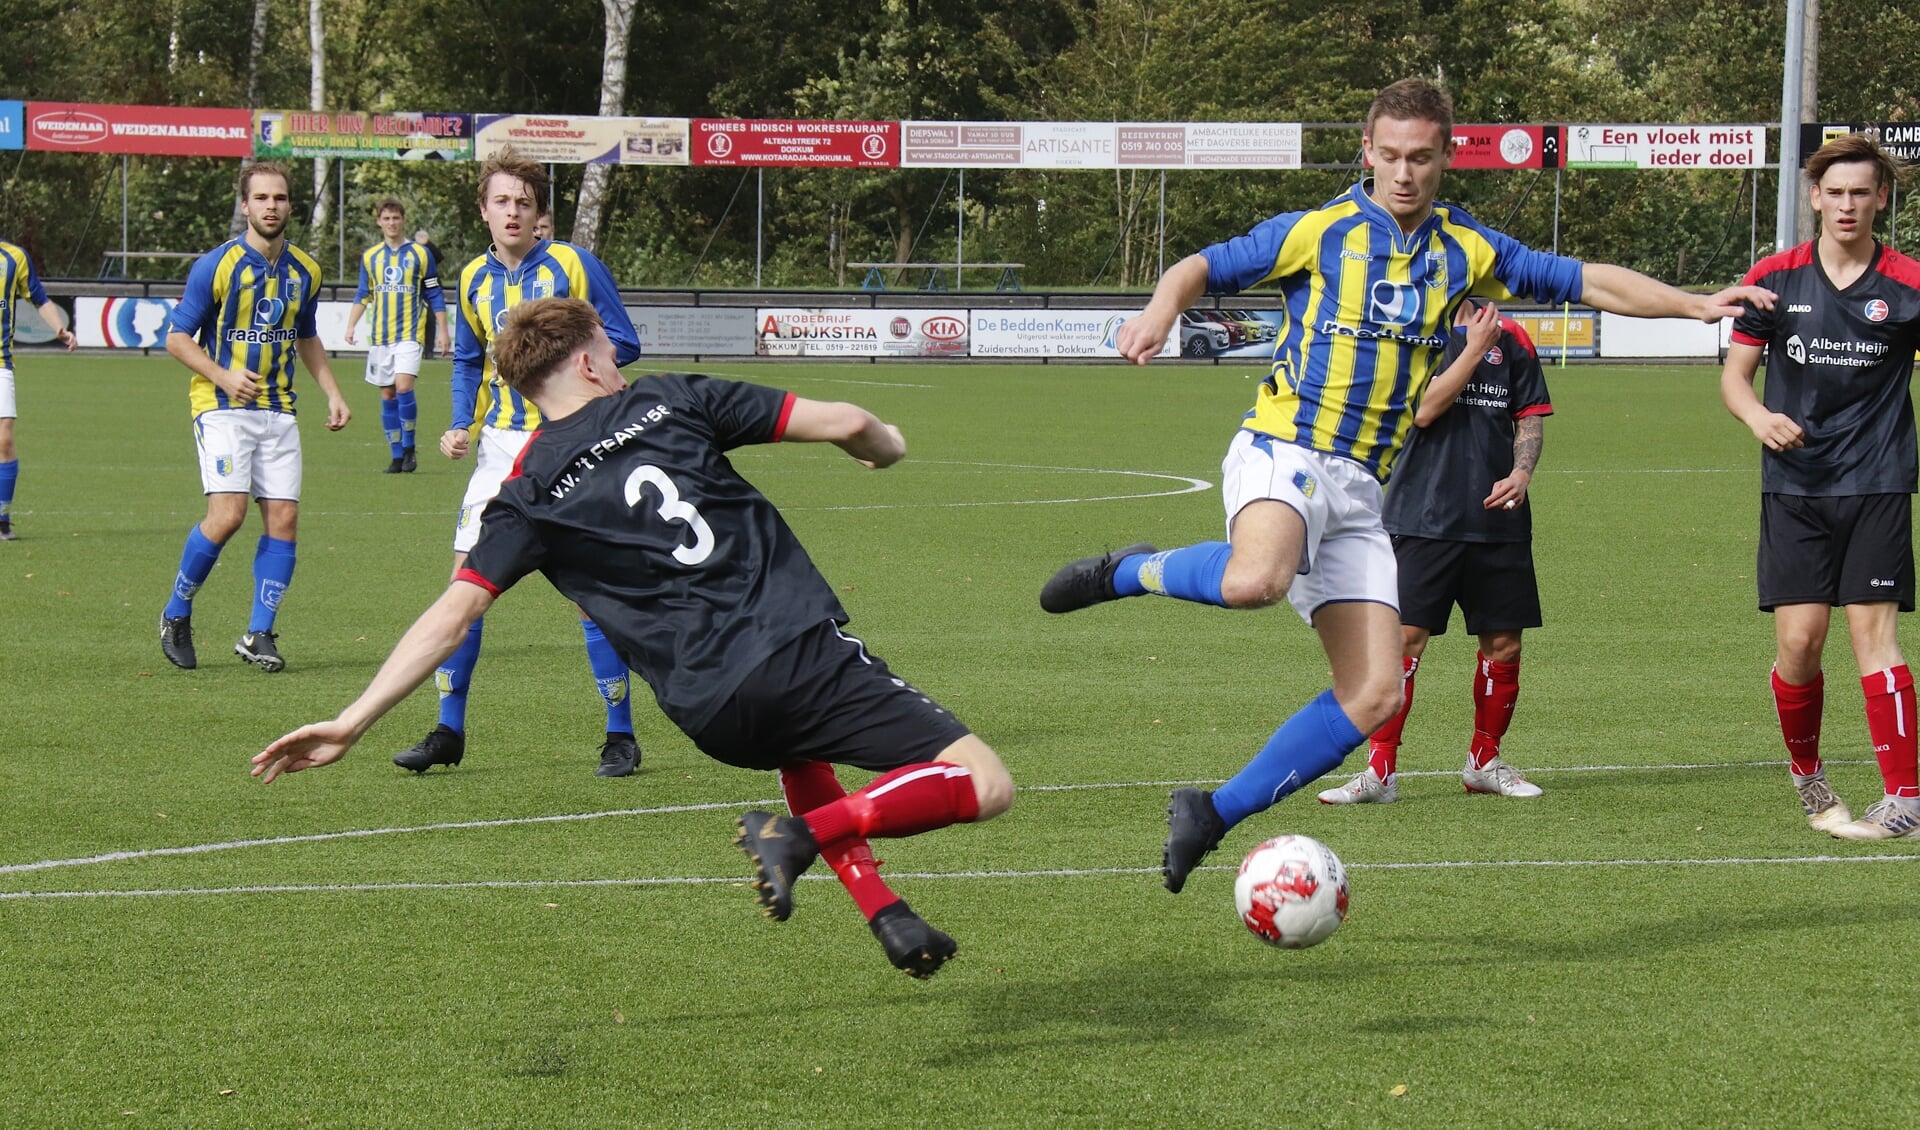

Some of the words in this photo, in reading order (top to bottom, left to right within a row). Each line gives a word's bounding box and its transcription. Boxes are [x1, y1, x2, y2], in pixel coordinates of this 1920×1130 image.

[37, 120, 104, 132] WEIDENAAR
[290, 114, 328, 134] HIER
[337, 114, 365, 134] UW
[701, 122, 746, 132] CHINEES
[751, 123, 793, 132] INDISCH
[798, 124, 890, 133] WOKRESTAURANT
[112, 123, 247, 139] WEIDENAARBBQ.NL
[910, 129, 948, 138] DIEPSWAL
[1121, 132, 1183, 140] RESERVEREN?
[1262, 129, 1297, 137] KEUKEN
[1602, 132, 1638, 145] Een
[1647, 129, 1701, 145] vloek
[1709, 129, 1754, 145] mist
[1026, 139, 1112, 154] ARTISANTE
[1121, 142, 1142, 151] 0519
[1145, 142, 1161, 151] 740
[1164, 143, 1183, 151] 005
[1187, 139, 1204, 147] MET
[1207, 138, 1250, 147] DAGVERSE
[1253, 139, 1297, 147] BEREIDING
[1650, 149, 1701, 165] ieder
[1709, 149, 1754, 165] doel
[1786, 304, 1812, 313] JAKO
[930, 322, 958, 335] KIA
[977, 319, 997, 331] De
[1000, 318, 1101, 332] BeddenKamer
[1540, 320, 1555, 331] #2
[1568, 320, 1582, 332] #3
[227, 328, 297, 343] raadsma
[791, 326, 878, 339] DIJKSTRA
[760, 343, 797, 353] DOKKUM
[806, 344, 823, 352] TEL.
[977, 345, 1039, 354] Zuiderschans
[1056, 345, 1096, 354] Dokkum
[1809, 337, 1852, 353] Albert
[1855, 342, 1889, 356] Heijn
[1479, 383, 1508, 398] Heijn
[590, 423, 645, 461] FEAN
[624, 464, 715, 565] 3
